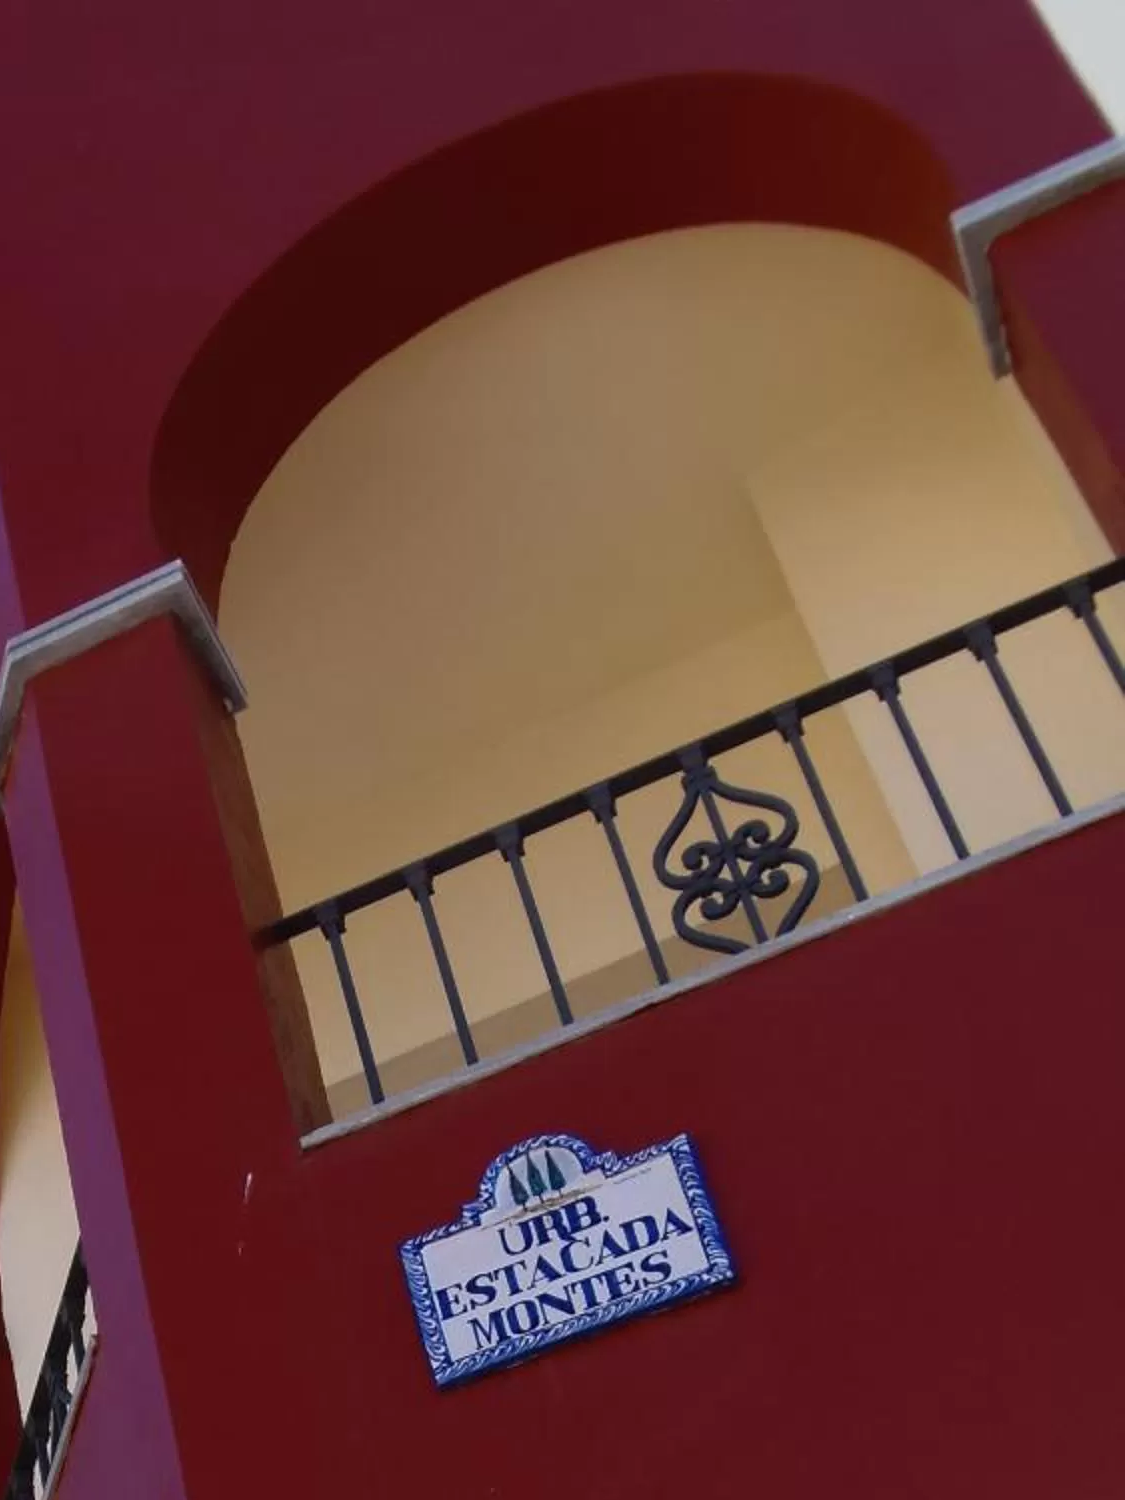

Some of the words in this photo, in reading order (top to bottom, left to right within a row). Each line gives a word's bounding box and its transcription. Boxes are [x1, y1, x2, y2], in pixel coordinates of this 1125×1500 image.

[435, 1208, 693, 1320] ESTACADA
[499, 1196, 610, 1256] URB.
[467, 1250, 673, 1349] MONTES
